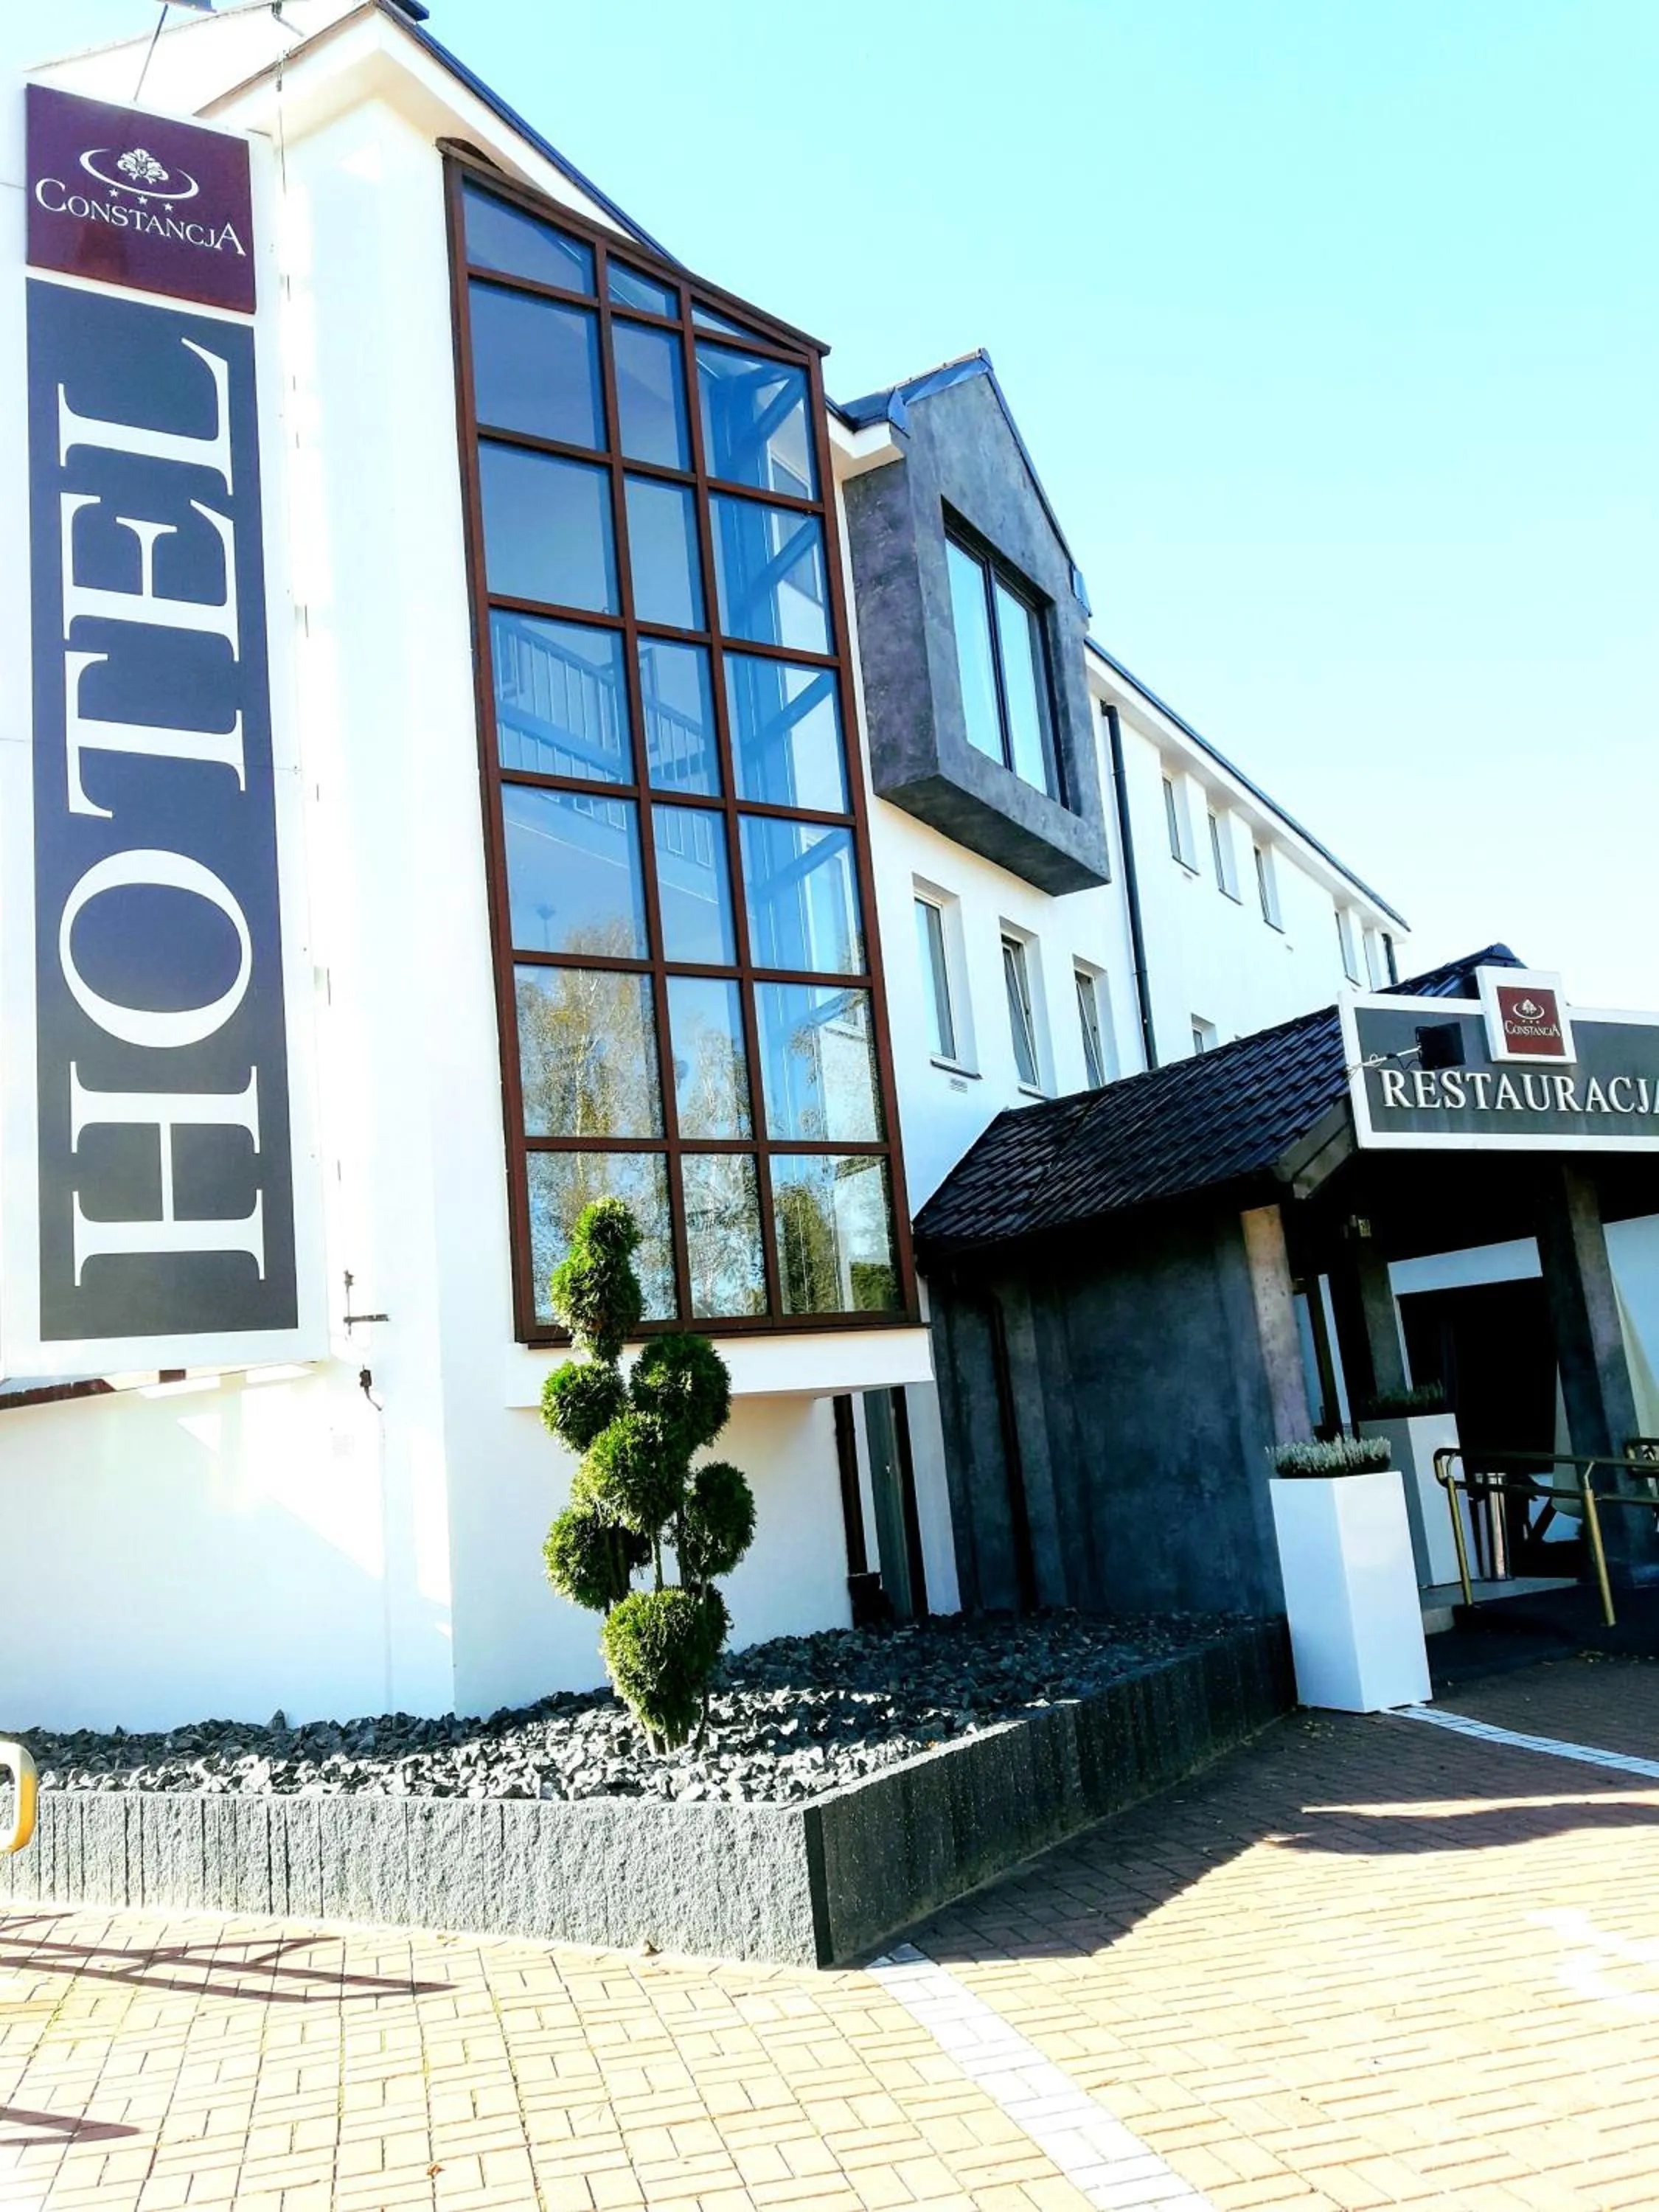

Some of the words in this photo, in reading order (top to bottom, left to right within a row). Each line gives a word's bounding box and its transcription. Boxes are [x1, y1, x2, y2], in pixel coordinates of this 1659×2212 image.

[35, 178, 246, 257] CONSTANCJA
[58, 338, 265, 1287] HOTEL
[1504, 1020, 1561, 1037] CONSTANCJA
[1380, 1069, 1659, 1114] RESTAURACJ
